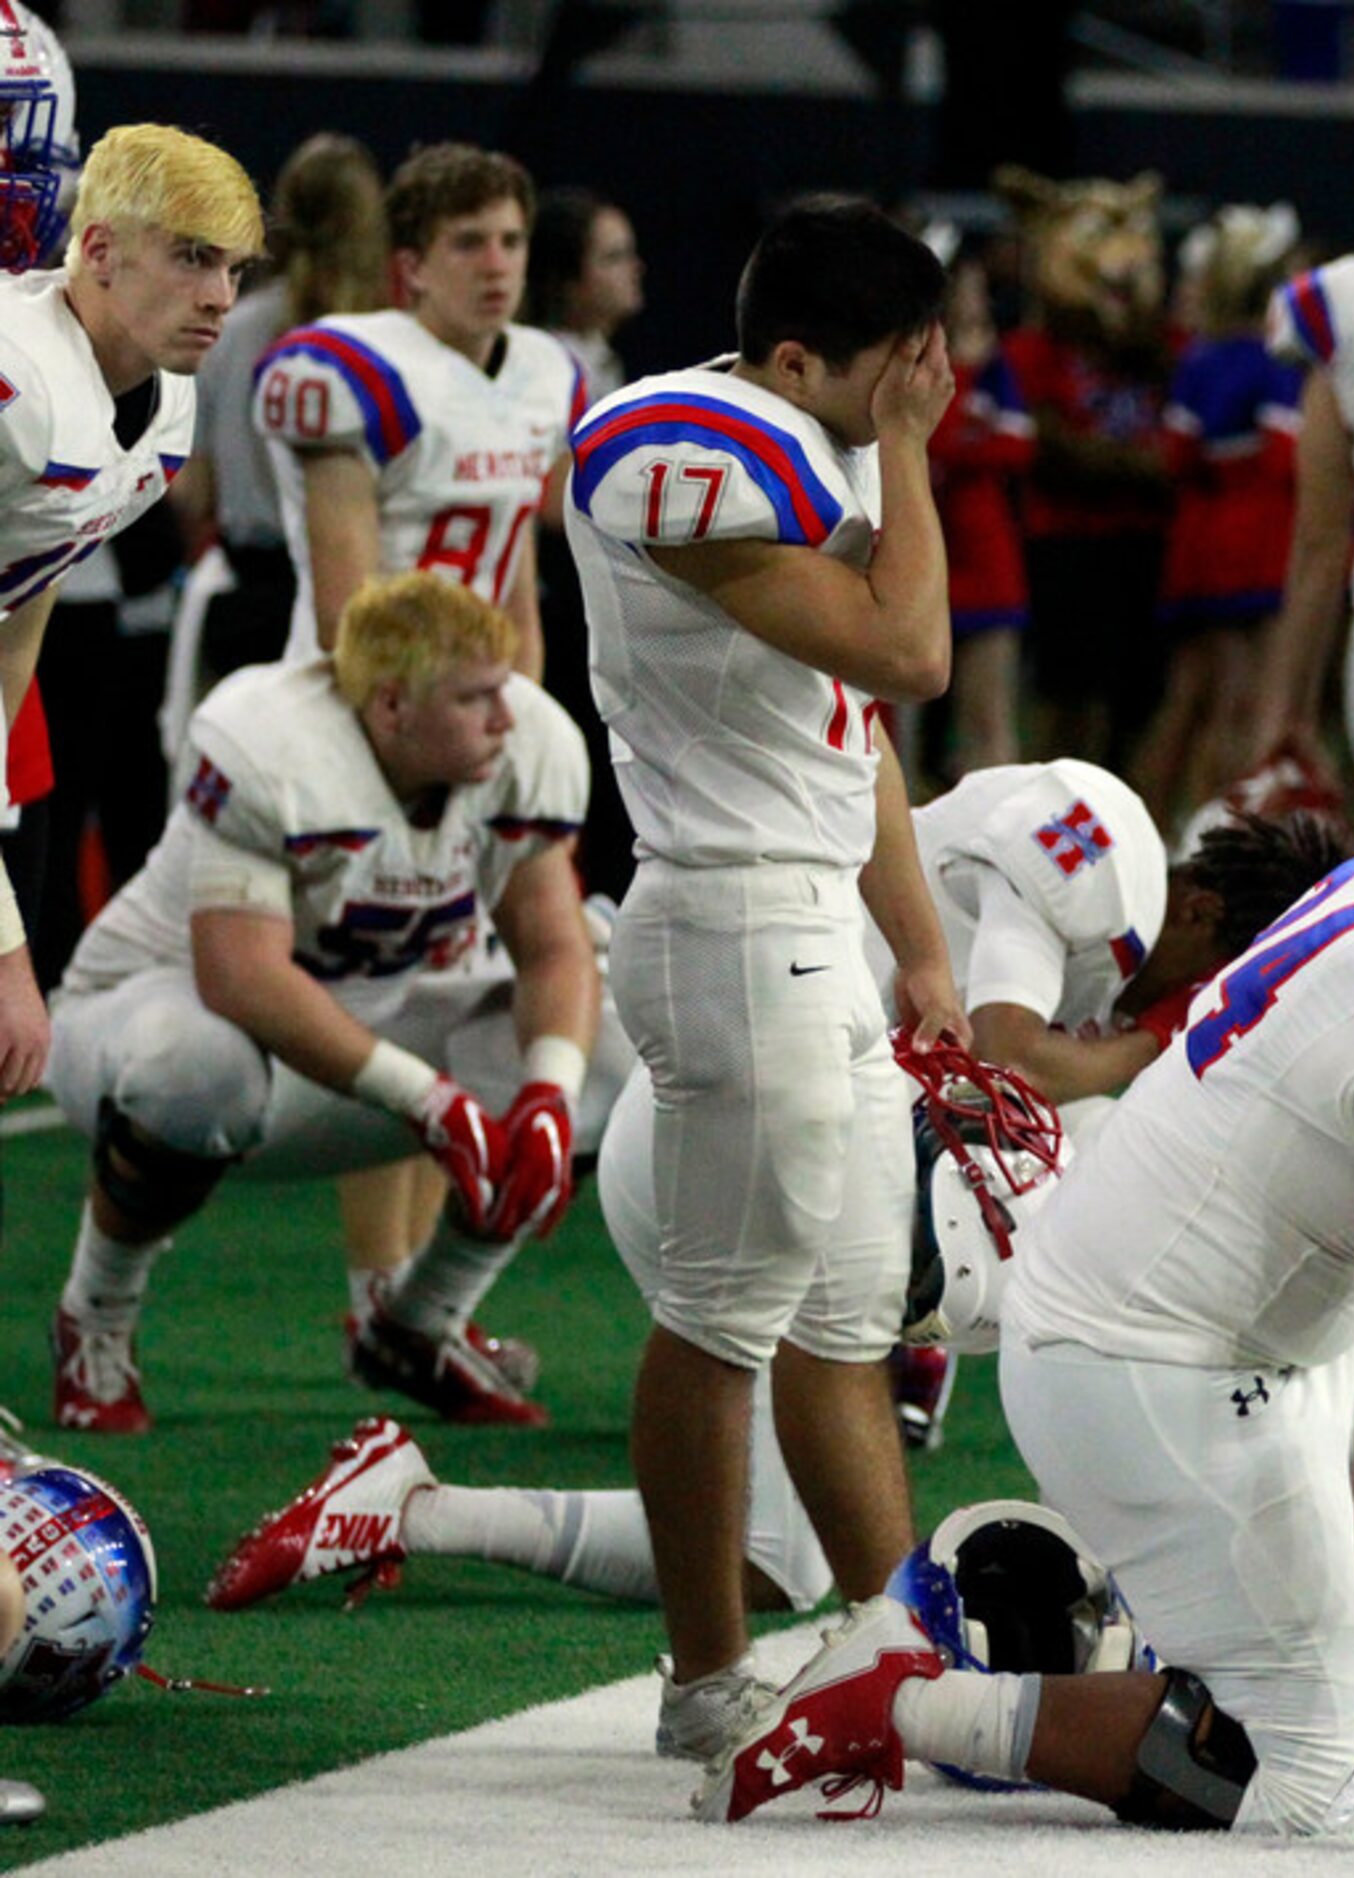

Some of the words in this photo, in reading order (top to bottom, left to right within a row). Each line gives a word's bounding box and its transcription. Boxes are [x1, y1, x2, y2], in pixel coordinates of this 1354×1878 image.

[263, 369, 330, 441] 80
[639, 456, 732, 546] 17
[315, 1512, 393, 1553] NIKE
